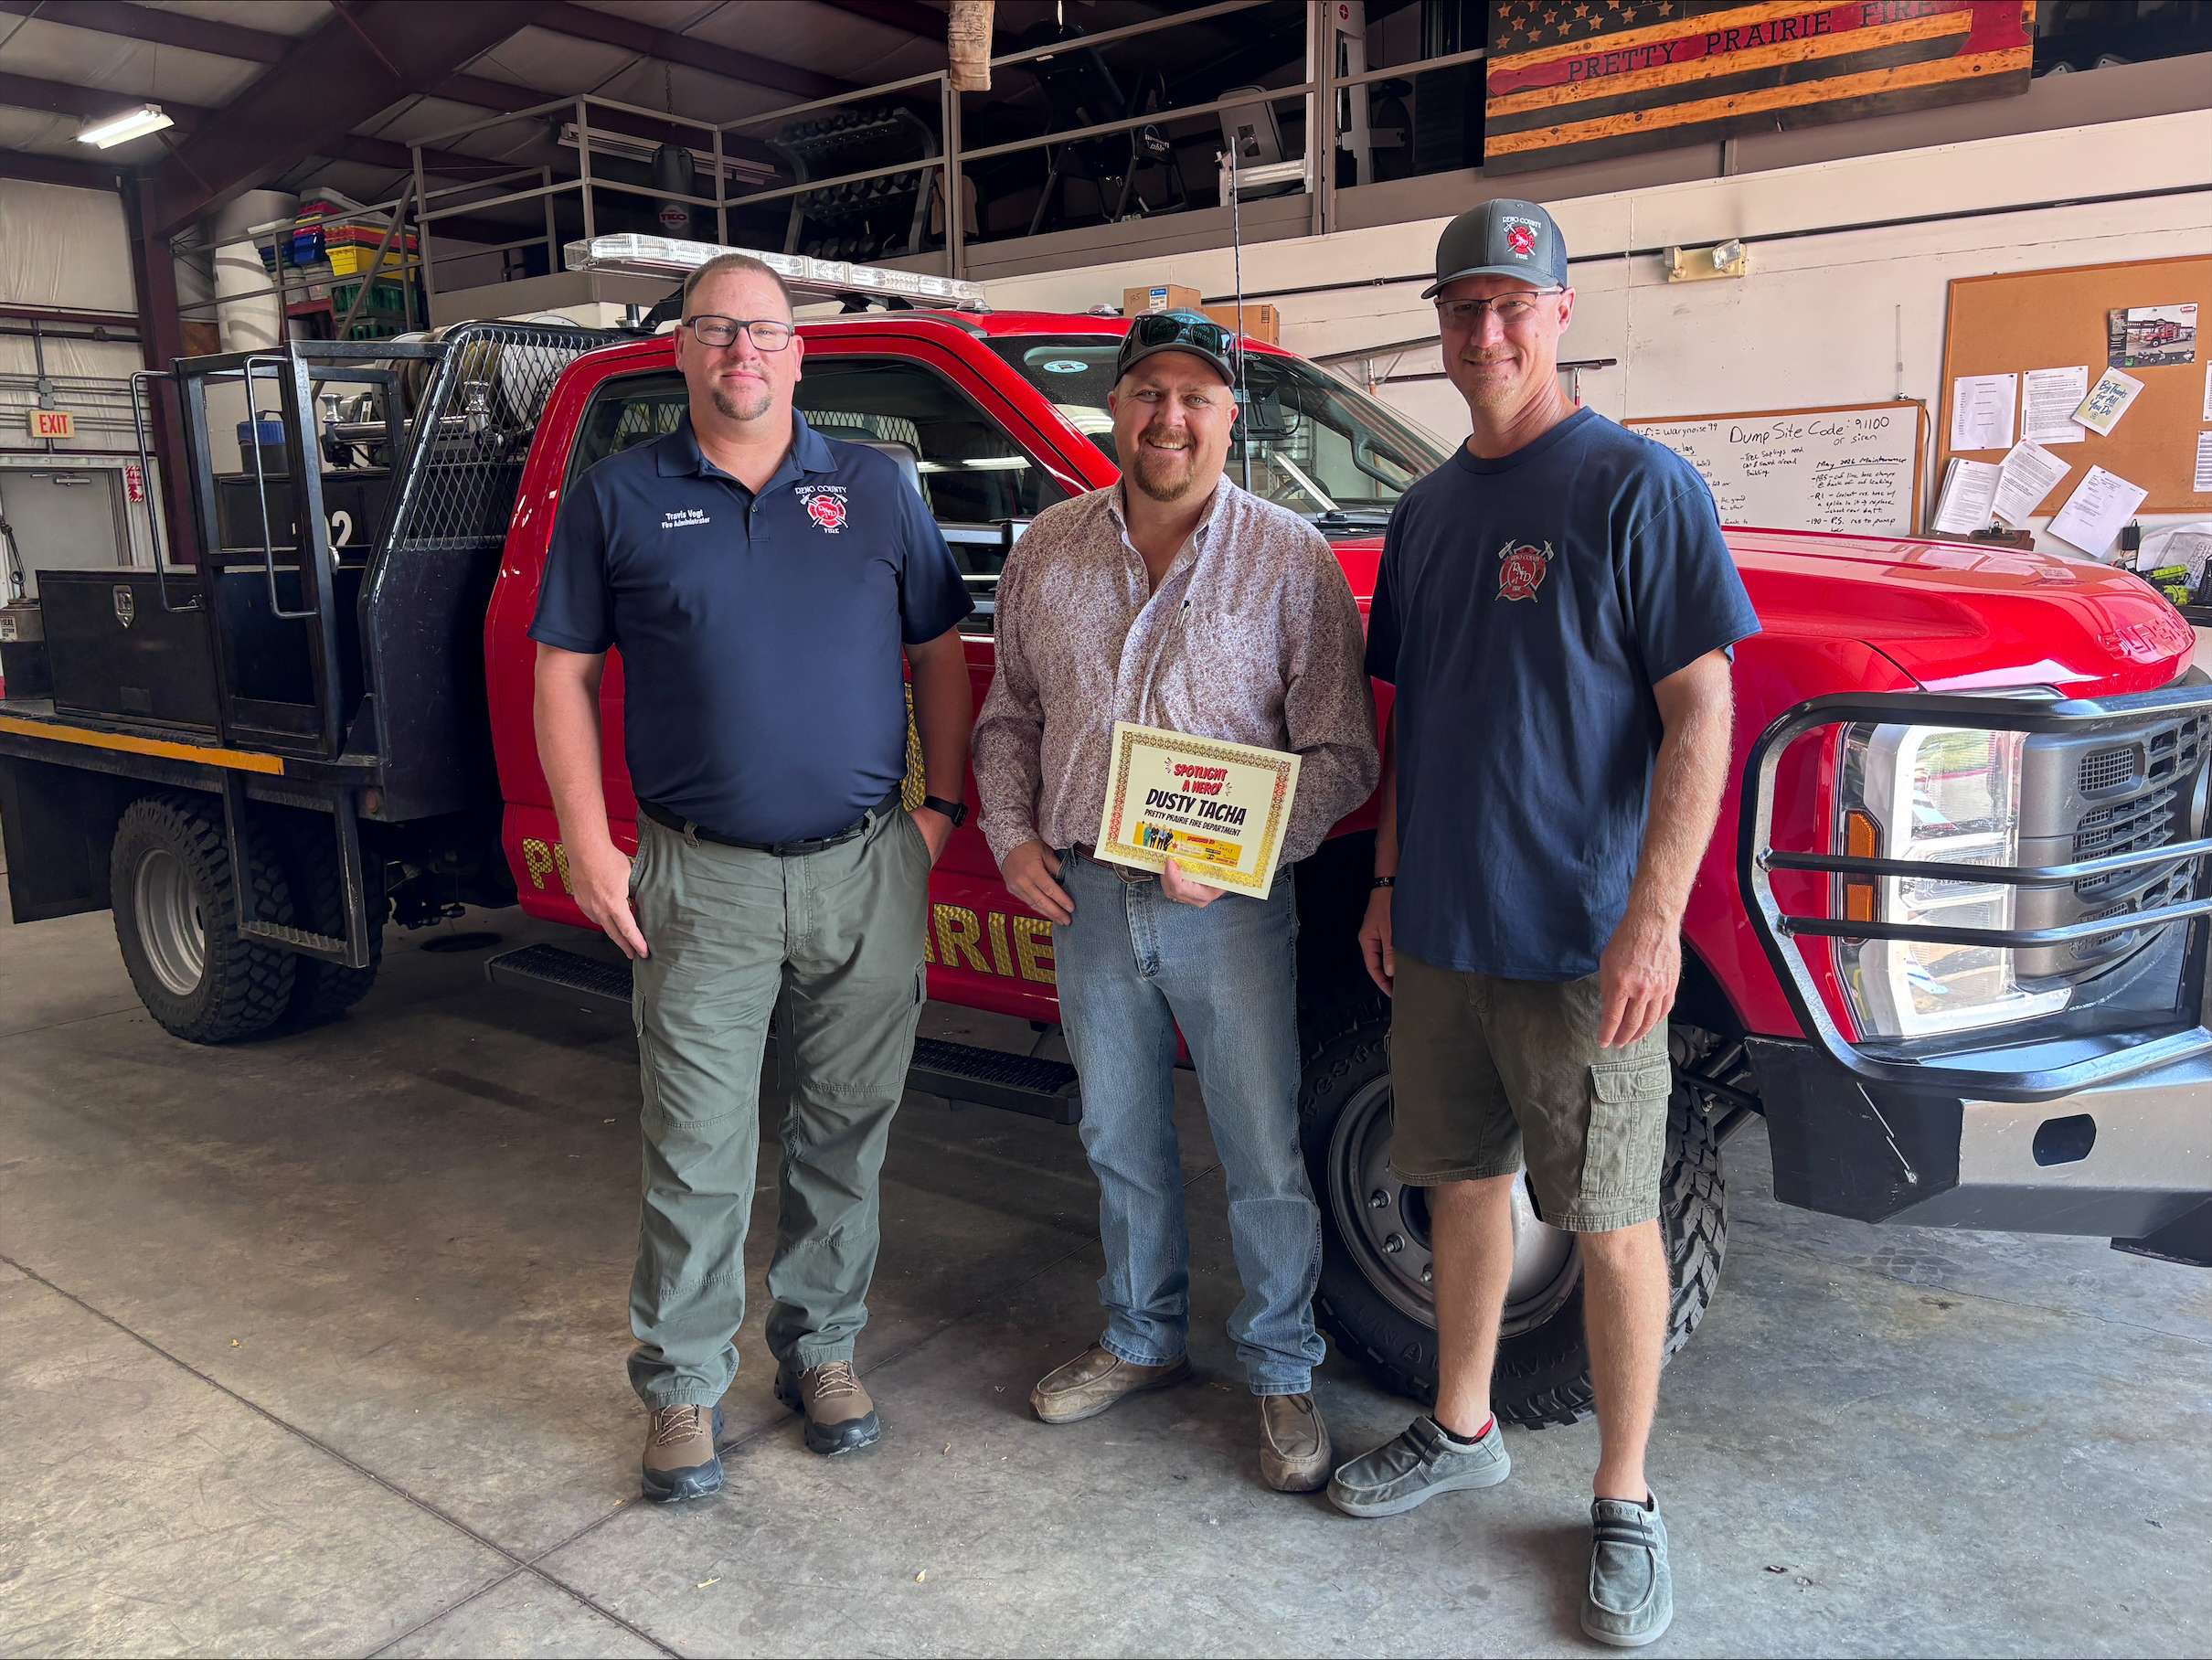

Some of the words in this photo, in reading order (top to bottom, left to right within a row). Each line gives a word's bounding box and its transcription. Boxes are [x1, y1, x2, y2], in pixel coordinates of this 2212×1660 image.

[1567, 41, 1679, 81] PRETTY
[1705, 12, 1832, 55] PRAIRIE
[1860, 1, 1937, 27] FIRE
[2105, 395, 2119, 404] All
[38, 414, 68, 434] EXIT
[1729, 425, 1770, 444] Dump
[1772, 422, 1803, 440] Site
[1833, 437, 1845, 446] or
[1850, 433, 1877, 444] siren
[1816, 461, 1834, 471] May
[794, 485, 816, 495] RENO
[816, 484, 847, 494] COUNTY
[665, 510, 686, 521] Travis
[687, 509, 704, 519] Vogt
[674, 516, 710, 527] Administrator
[1174, 763, 1228, 782] SPOTLIGHT
[1182, 780, 1190, 793] A
[1191, 781, 1223, 795] HERO!
[1145, 788, 1196, 814] DUSTY
[1197, 799, 1248, 825] TACHA
[1144, 808, 1166, 820] PRETTY
[1165, 813, 1189, 825] PRAIRIE
[1188, 818, 1203, 828] FIRE
[1202, 822, 1241, 837] DEPARTMENT
